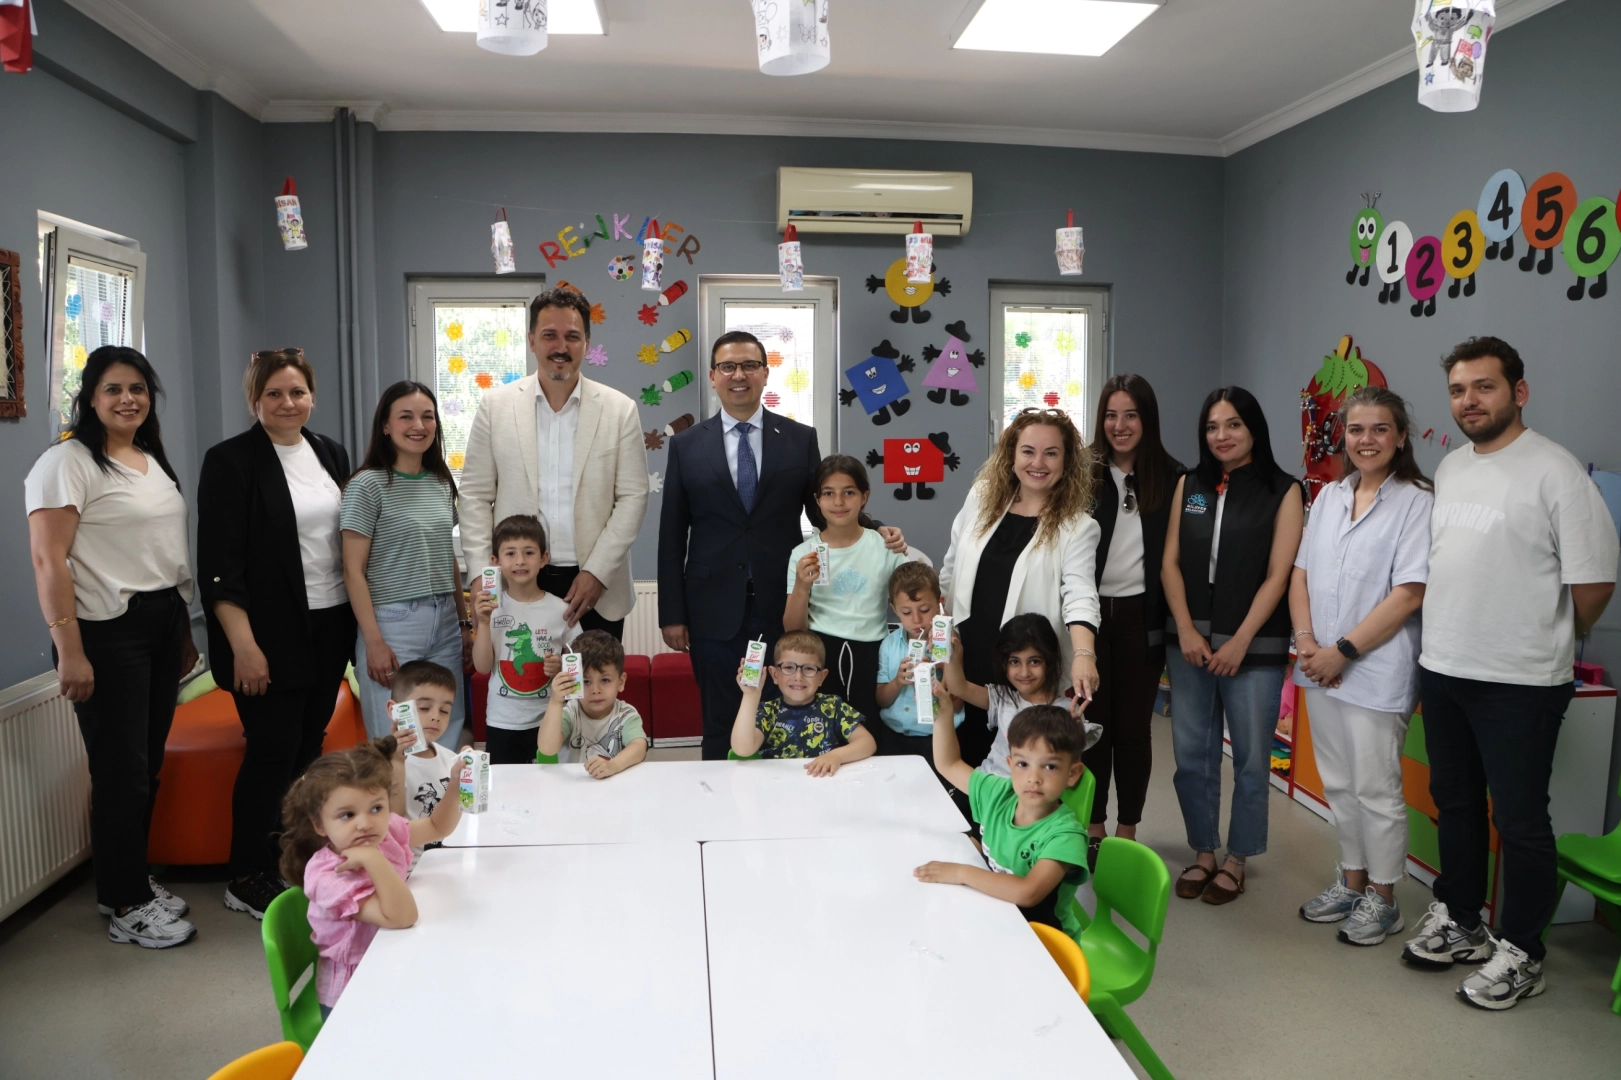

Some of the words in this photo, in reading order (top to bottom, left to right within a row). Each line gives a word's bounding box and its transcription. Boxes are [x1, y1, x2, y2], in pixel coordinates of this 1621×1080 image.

[1387, 230, 1398, 274] 1
[1416, 243, 1435, 288] 2
[1452, 221, 1473, 268] 3
[1487, 181, 1514, 230] 4
[1535, 185, 1563, 241] 5
[1576, 205, 1607, 264] 6
[493, 617, 513, 627] Hello!
